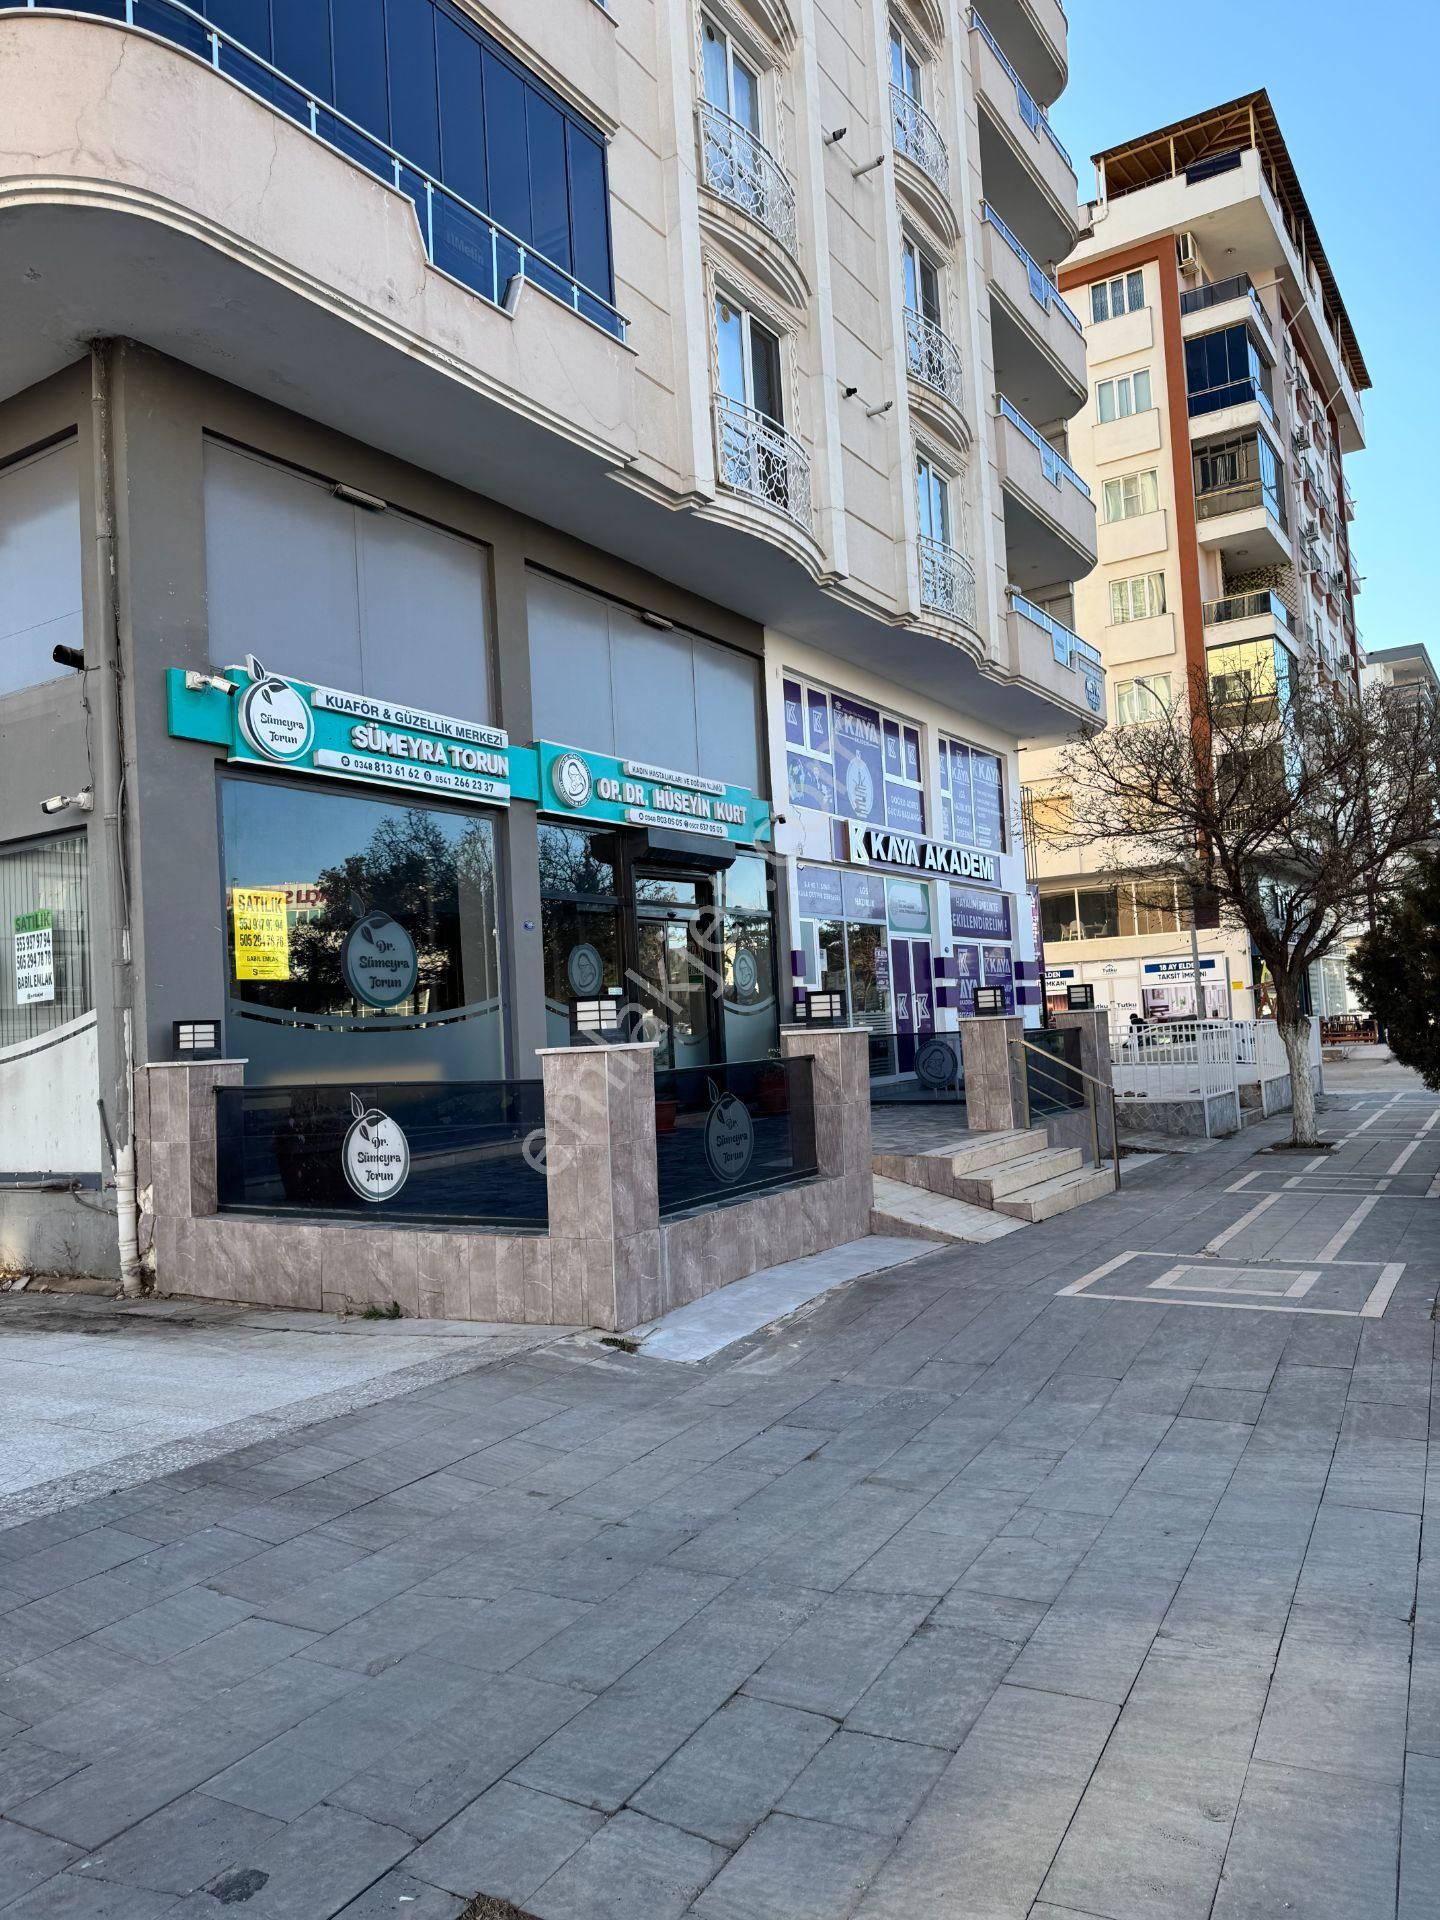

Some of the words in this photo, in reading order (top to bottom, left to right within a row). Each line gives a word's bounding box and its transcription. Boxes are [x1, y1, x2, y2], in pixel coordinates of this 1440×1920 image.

[260, 713, 305, 732] Sümeyra
[325, 694, 379, 718] KUAFÖR
[383, 708, 392, 720] &
[395, 710, 452, 735] GÜZELLİK
[455, 727, 504, 746] MERKEZİ
[268, 730, 298, 744] Torun
[352, 722, 448, 765] SÜMEYRA
[448, 744, 509, 777] TORUN
[354, 760, 373, 771] 0348
[374, 761, 393, 775] 813
[395, 765, 406, 777] 61
[408, 767, 420, 779] 62
[435, 775, 451, 785] 0541
[454, 776, 470, 789] 266
[472, 779, 482, 790] 23
[484, 781, 494, 793] 37
[653, 785, 711, 818] HÜSEYİN
[714, 802, 747, 825] KURT
[871, 831, 920, 867] KAYA
[238, 894, 282, 914] SATILIK
[15, 911, 50, 932] SATILIK
[952, 911, 1003, 932] EKİLLENDİRELİM
[239, 934, 253, 947] 505
[375, 940, 395, 953] Dr.
[359, 955, 409, 972] Sümeyra
[1178, 962, 1195, 970] ELDE
[369, 975, 402, 989] Torun
[1044, 971, 1060, 979] LDEN
[1158, 972, 1180, 980] TAKSİT
[1182, 970, 1207, 979] İMKNI
[371, 1136, 389, 1149] Dr.
[357, 1151, 401, 1167] Sümeyra
[365, 1169, 393, 1182] Torun
